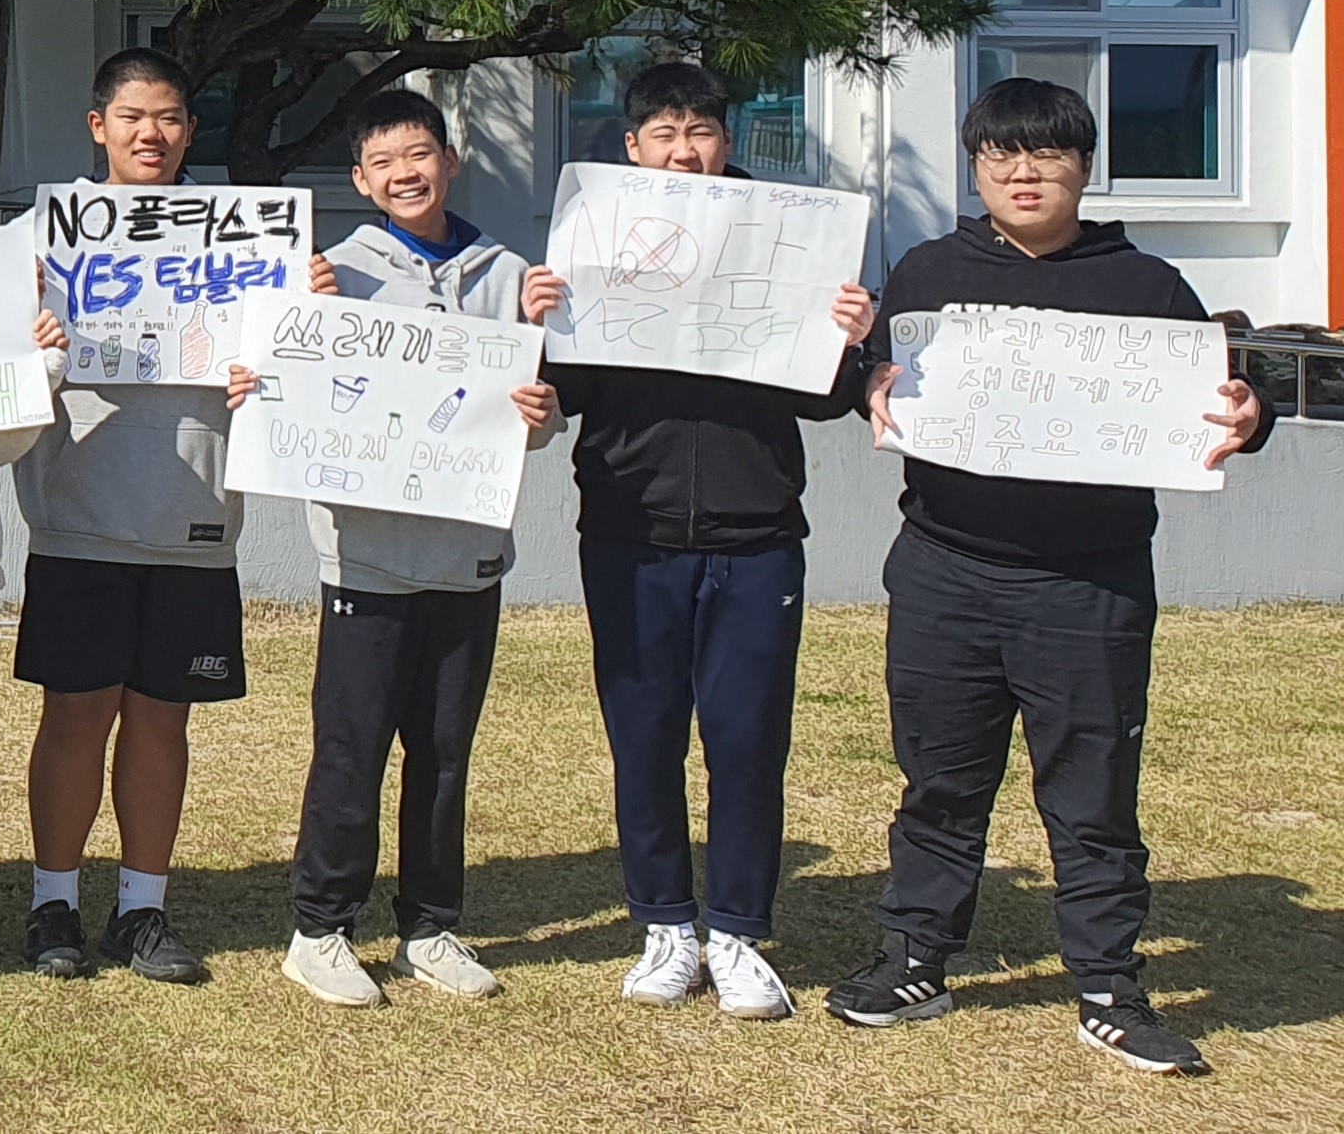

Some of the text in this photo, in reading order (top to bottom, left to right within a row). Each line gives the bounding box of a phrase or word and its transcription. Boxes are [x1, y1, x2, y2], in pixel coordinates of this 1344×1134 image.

[618, 172, 655, 197] 우리
[703, 181, 755, 204] 함께
[48, 192, 299, 249] NO 플라스틱
[46, 251, 287, 321] YES 텀블러
[273, 306, 469, 372] 쓰레기를
[957, 366, 1163, 411] 생태계가
[270, 419, 387, 461] 버리지
